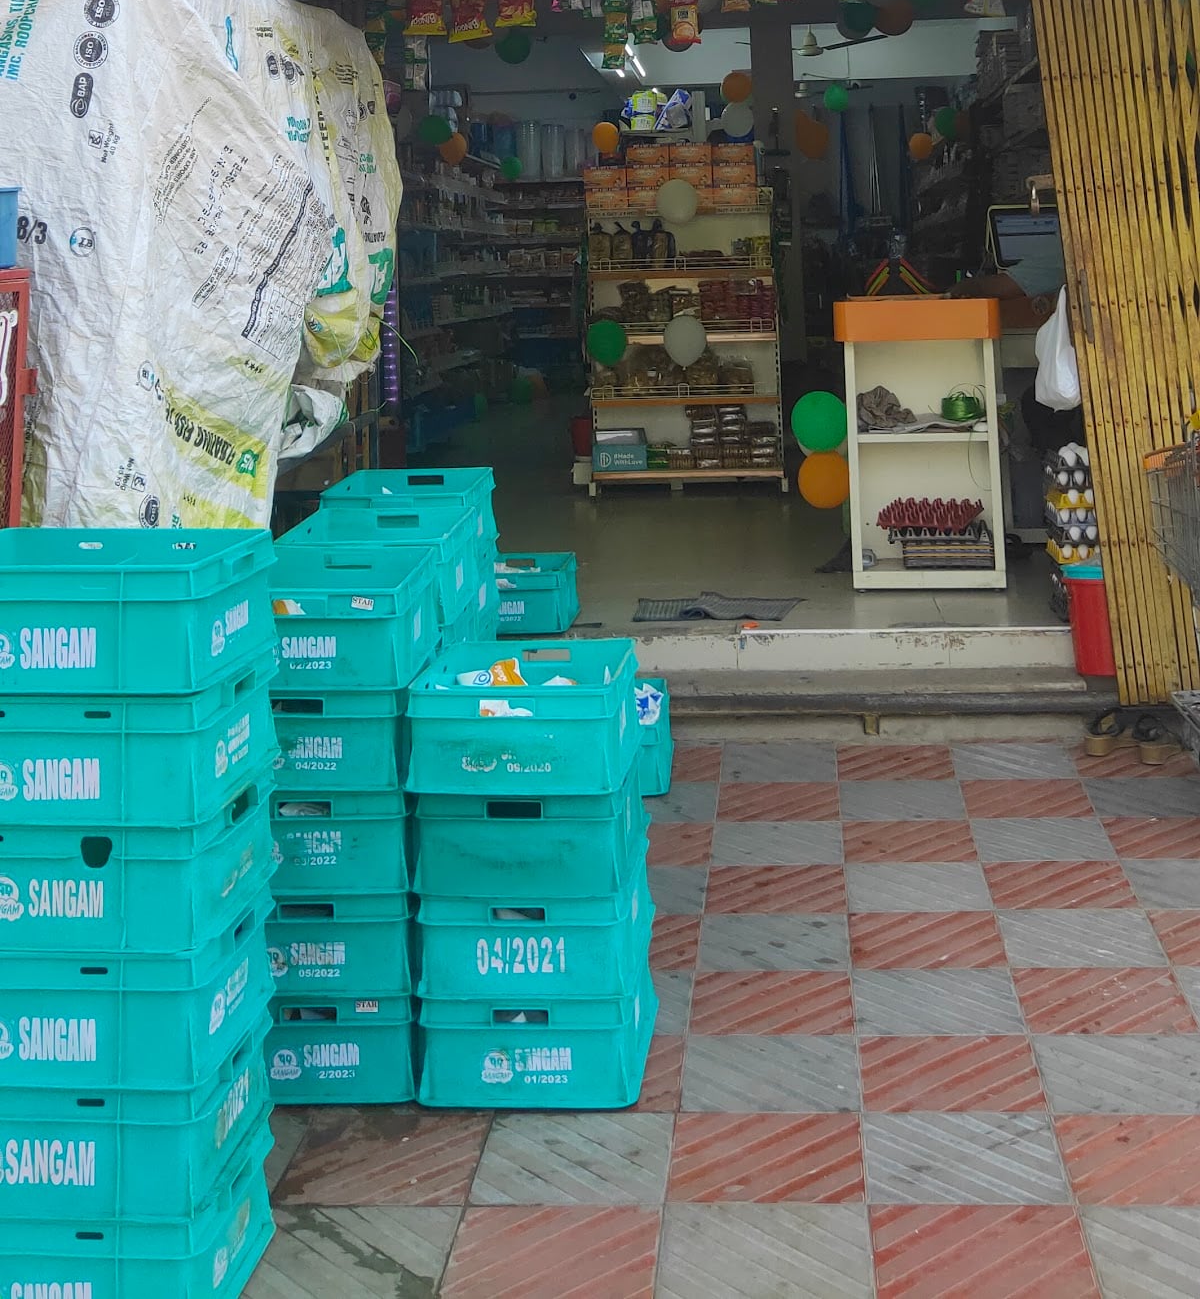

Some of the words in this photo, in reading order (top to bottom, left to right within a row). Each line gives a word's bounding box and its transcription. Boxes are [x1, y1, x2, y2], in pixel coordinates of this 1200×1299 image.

[94, 0, 106, 20] ISO
[84, 41, 94, 58] ISO
[77, 76, 88, 98] BAP
[20, 627, 97, 670] SANGAM
[282, 636, 337, 659] SANGAM
[22, 757, 101, 802] SANGAM
[28, 879, 104, 919] SANGAM
[290, 942, 346, 966] SANGAM
[476, 936, 566, 975] 04/2021
[298, 968, 341, 978] 05/2022
[18, 1016, 97, 1062] SANGAM
[303, 1042, 360, 1068] SANGAM
[515, 1047, 573, 1072] SANGAM
[524, 1074, 568, 1084] 01/2023
[5, 1139, 96, 1188] SANGAM
